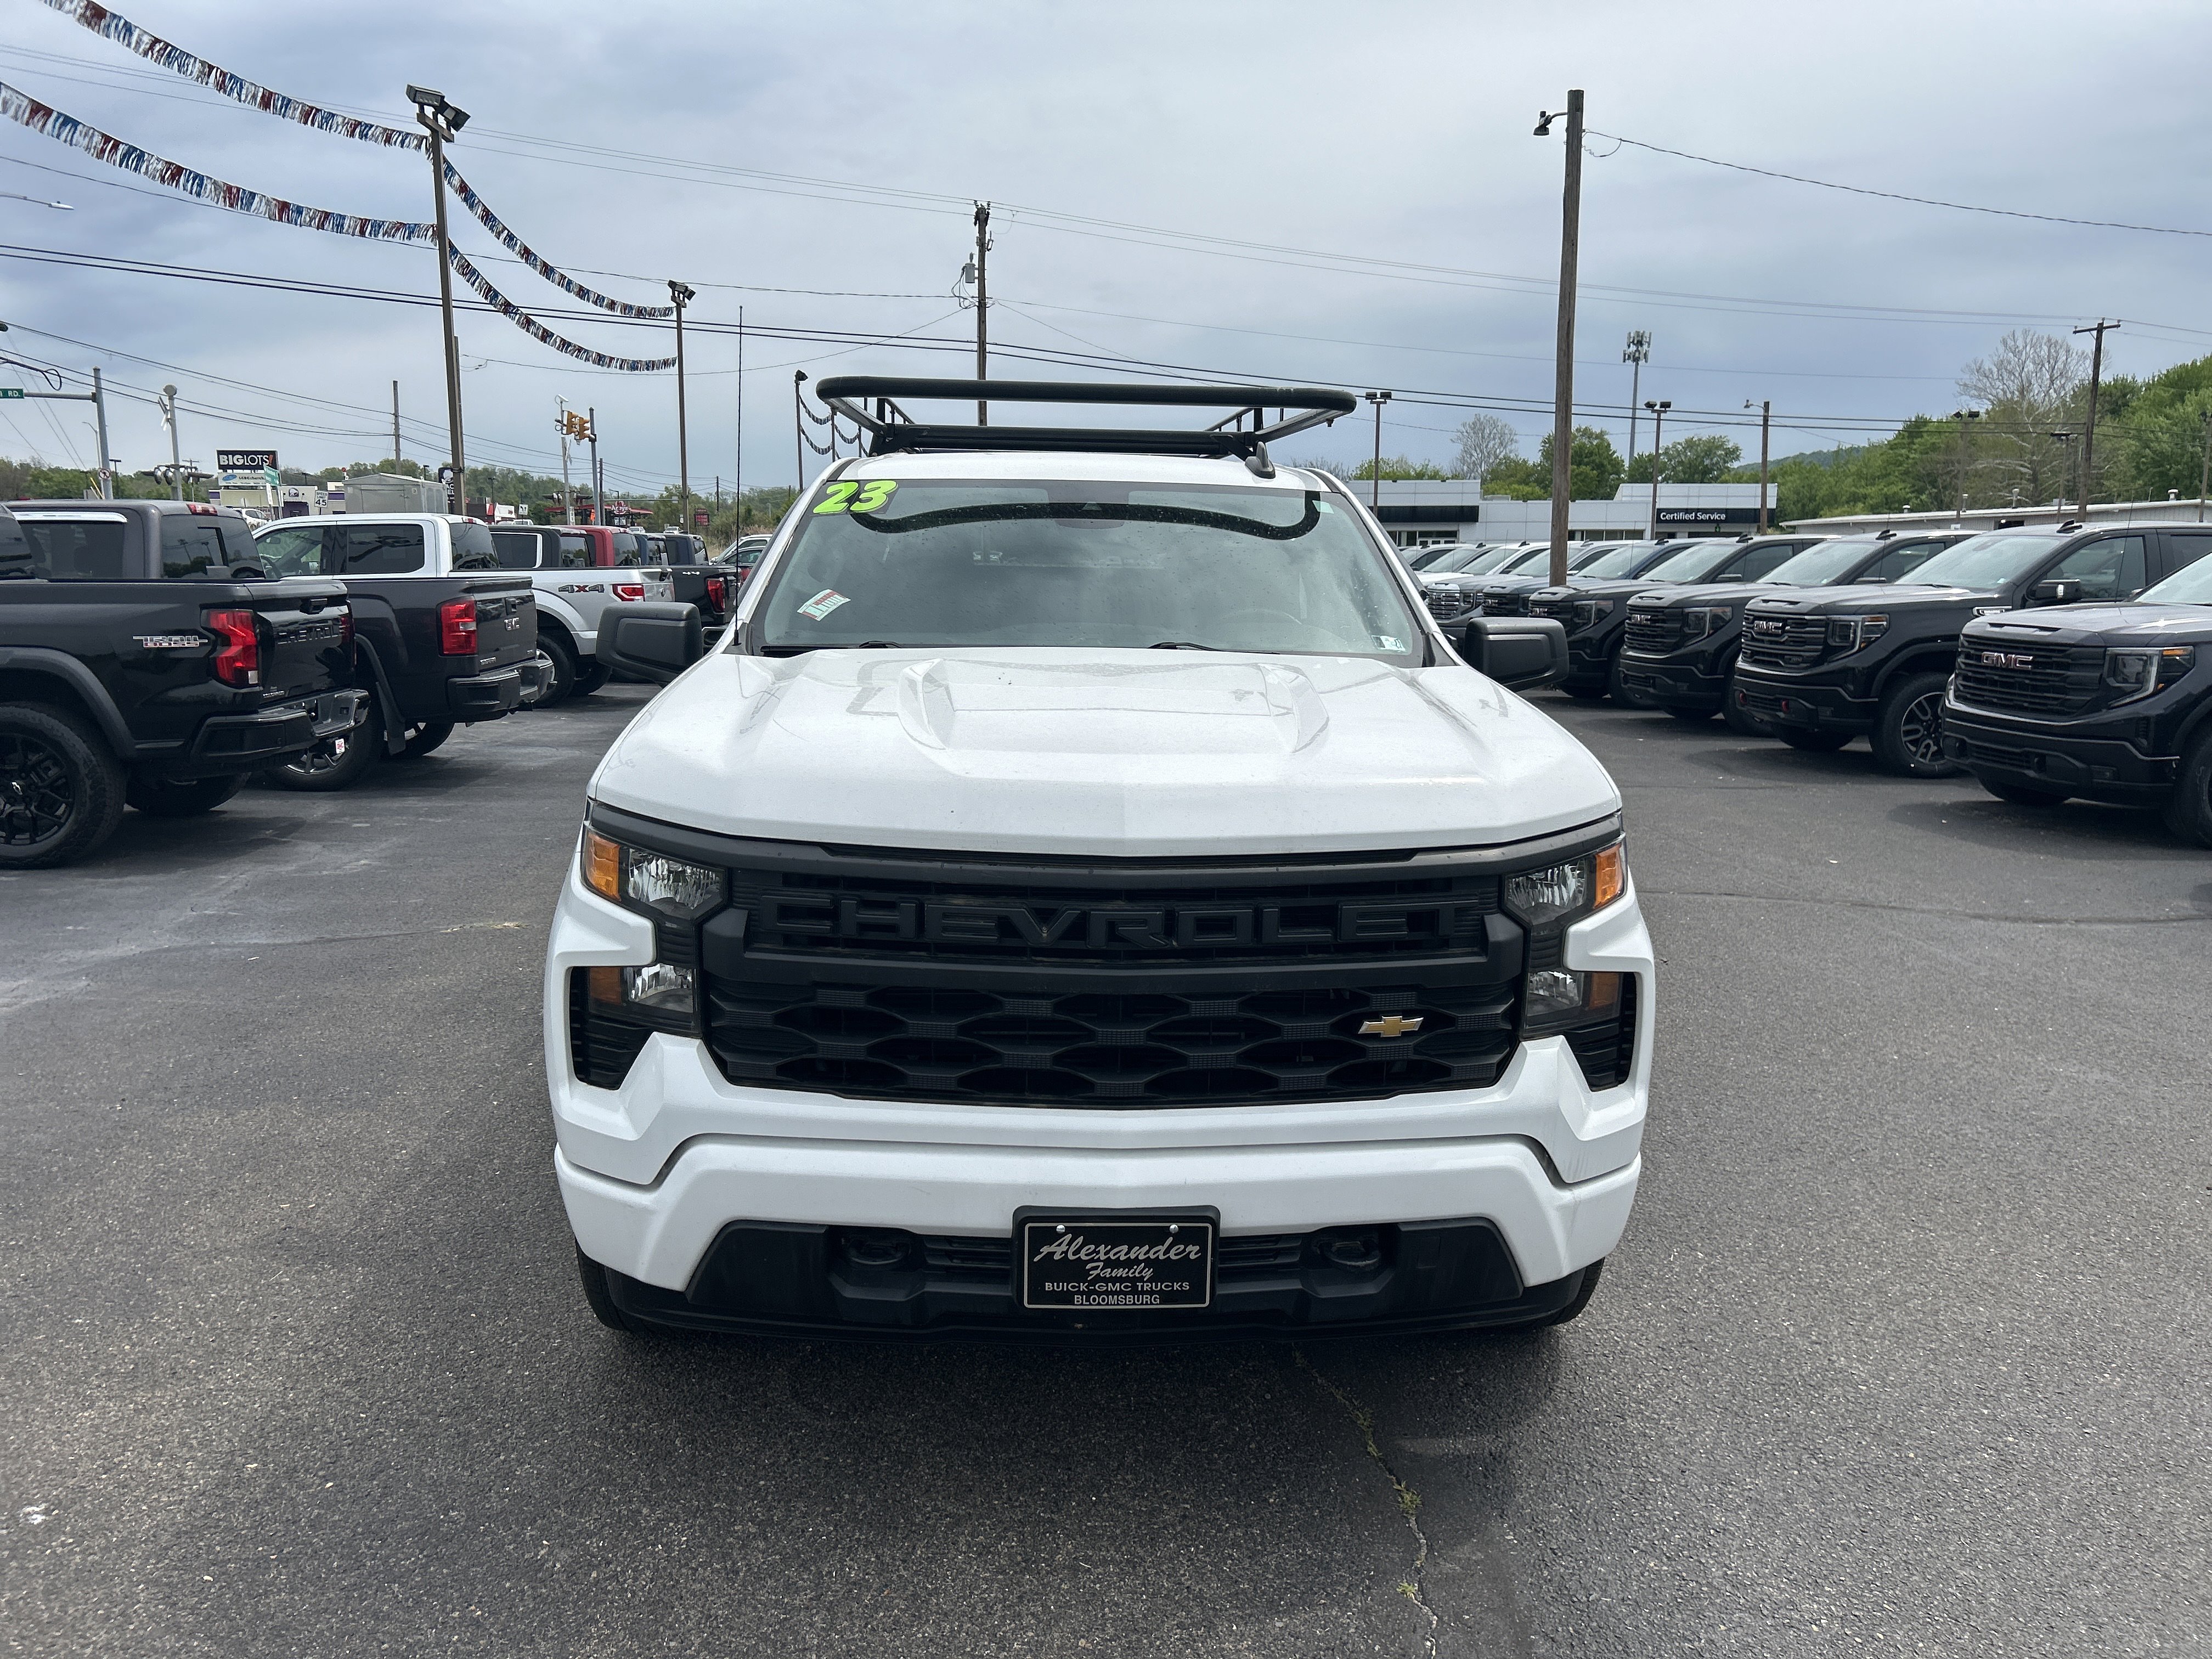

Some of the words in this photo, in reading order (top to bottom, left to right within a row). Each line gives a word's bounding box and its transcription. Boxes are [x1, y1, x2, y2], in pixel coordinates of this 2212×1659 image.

[813, 481, 899, 514] 23
[1660, 512, 1695, 521] Certified
[1697, 512, 1726, 521] Service
[1754, 620, 1782, 634] GMC
[1981, 651, 2033, 670] GMC
[759, 893, 1480, 949] CHEVROLET
[1033, 1233, 1201, 1262] Alexander
[1085, 1262, 1154, 1281] Family
[1045, 1282, 1132, 1291] BUICK-GMC
[1137, 1282, 1190, 1291] TRUCKS
[1074, 1294, 1160, 1305] BLOOMSBURG
